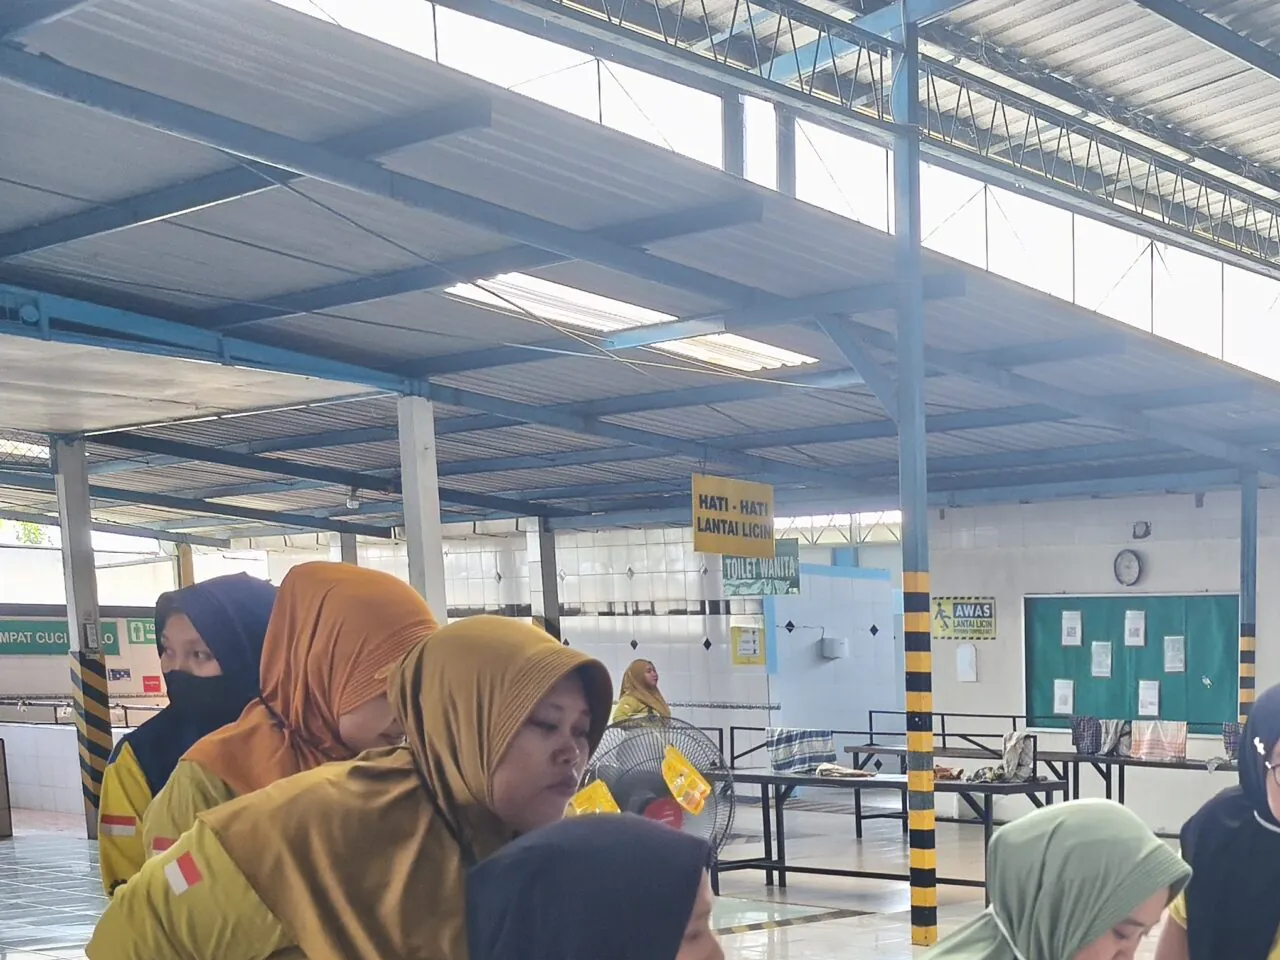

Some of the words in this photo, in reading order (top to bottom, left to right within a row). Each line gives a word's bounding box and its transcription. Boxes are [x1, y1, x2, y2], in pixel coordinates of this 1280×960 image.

[699, 494, 728, 511] HATI
[740, 500, 769, 517] HATI
[697, 517, 740, 537] LANTAI
[742, 523, 772, 540] LICIN
[725, 557, 757, 579] TOILET
[760, 556, 796, 578] WANITA
[955, 604, 990, 617] AWAS
[953, 619, 975, 628] LANTAI
[976, 619, 993, 628] LICIN
[36, 632, 68, 644] CUCI
